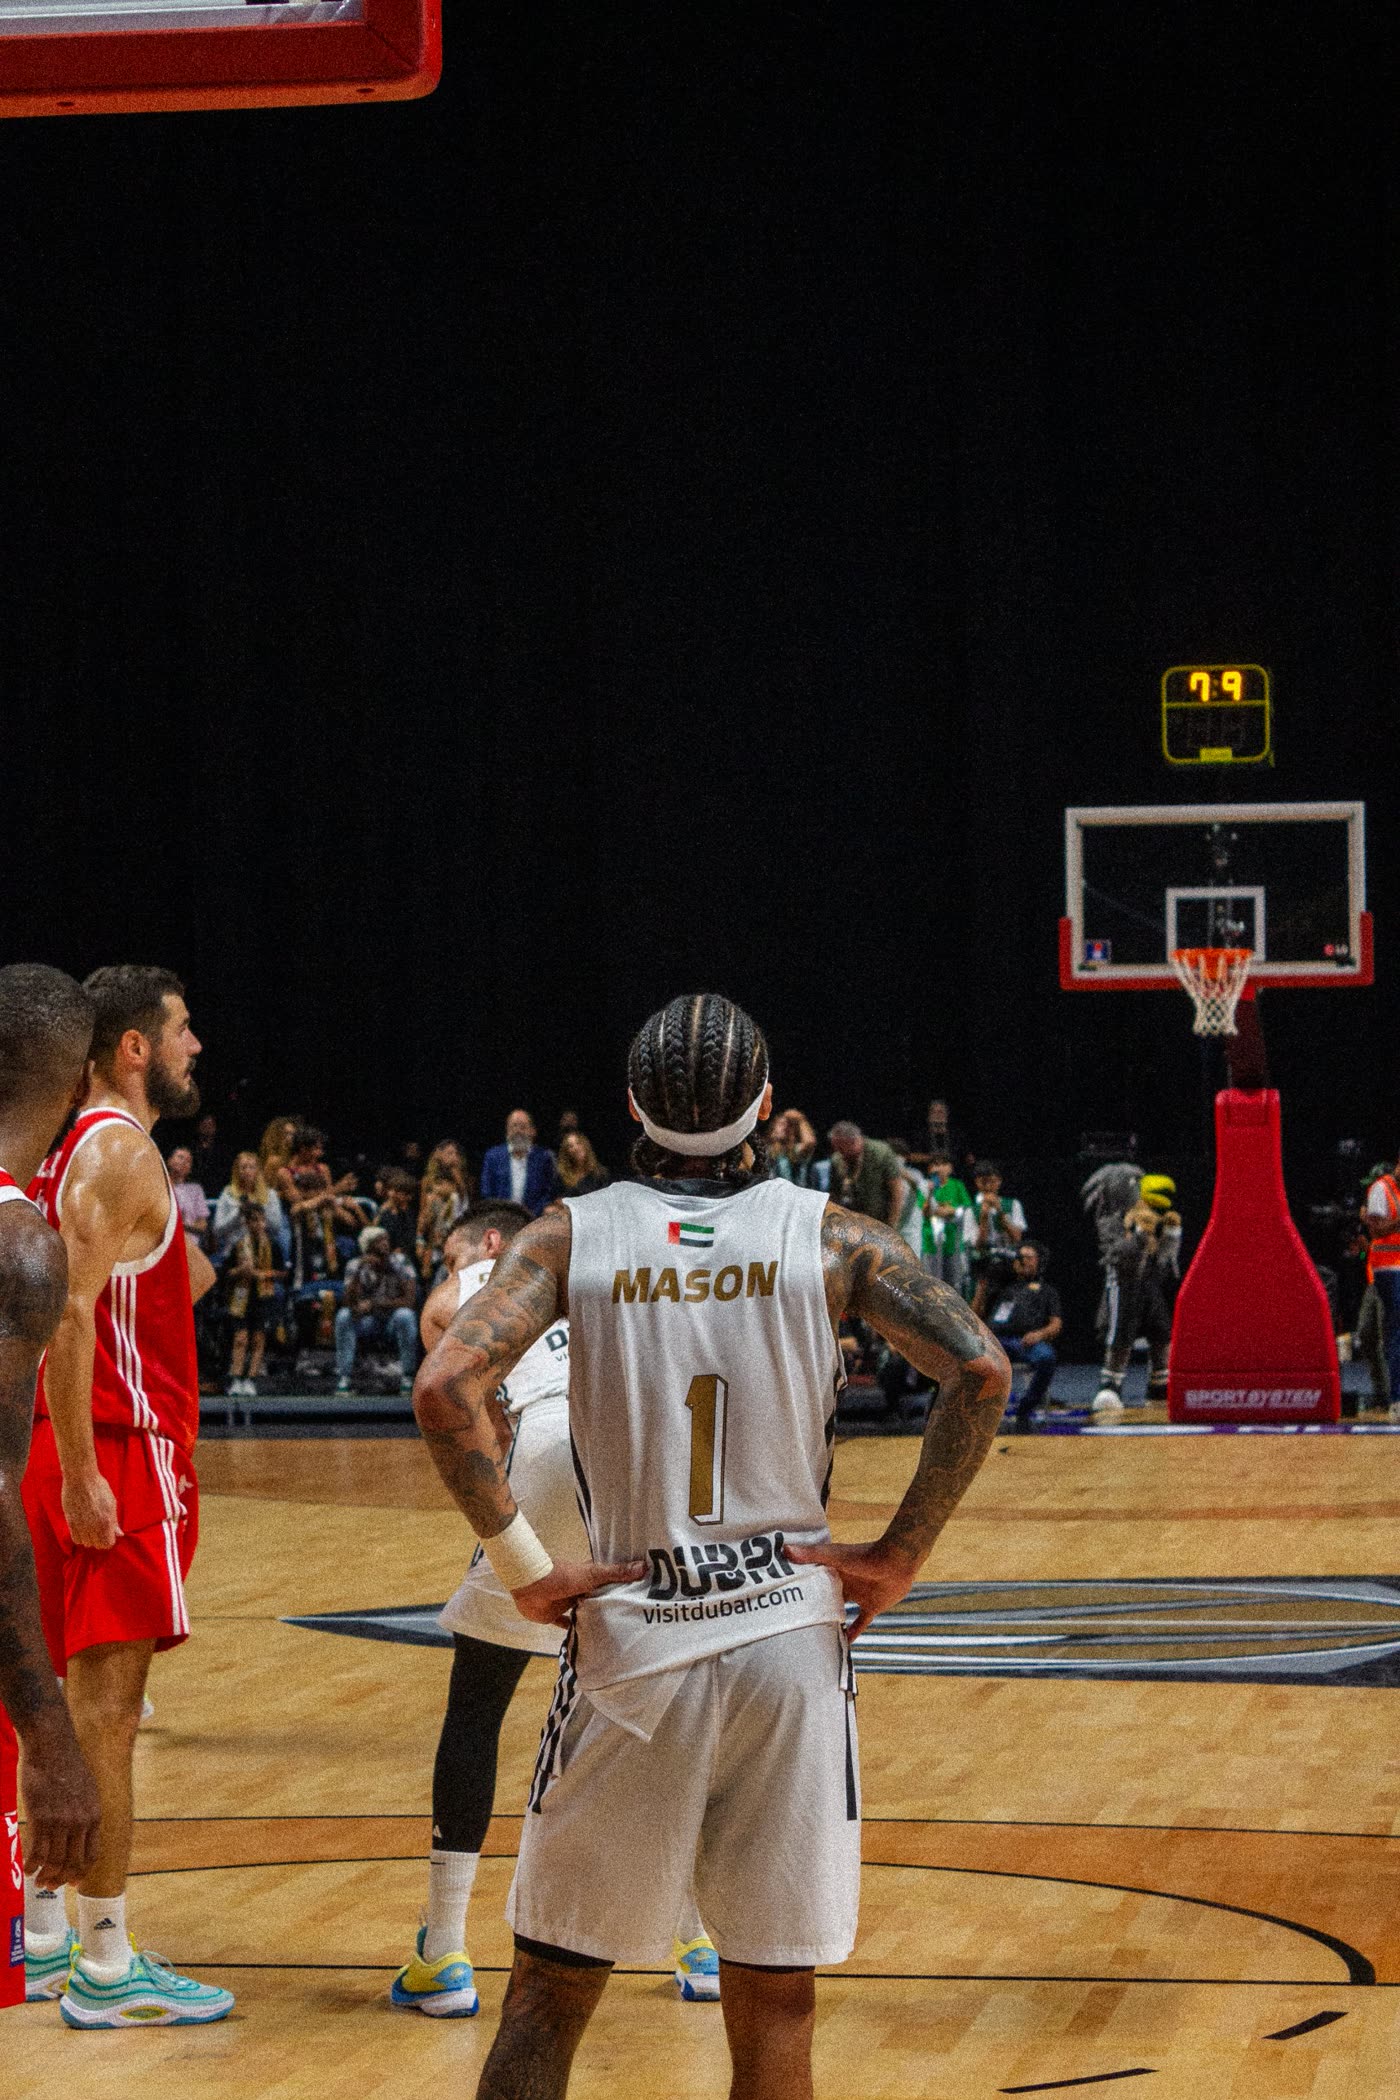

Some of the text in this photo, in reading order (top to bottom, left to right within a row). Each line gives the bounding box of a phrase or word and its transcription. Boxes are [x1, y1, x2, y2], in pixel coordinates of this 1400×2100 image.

[612, 1261, 779, 1304] MASON
[684, 1373, 728, 1526] 1
[647, 1532, 795, 1600] DUBAI
[643, 1586, 804, 1624] visitdubai.com
